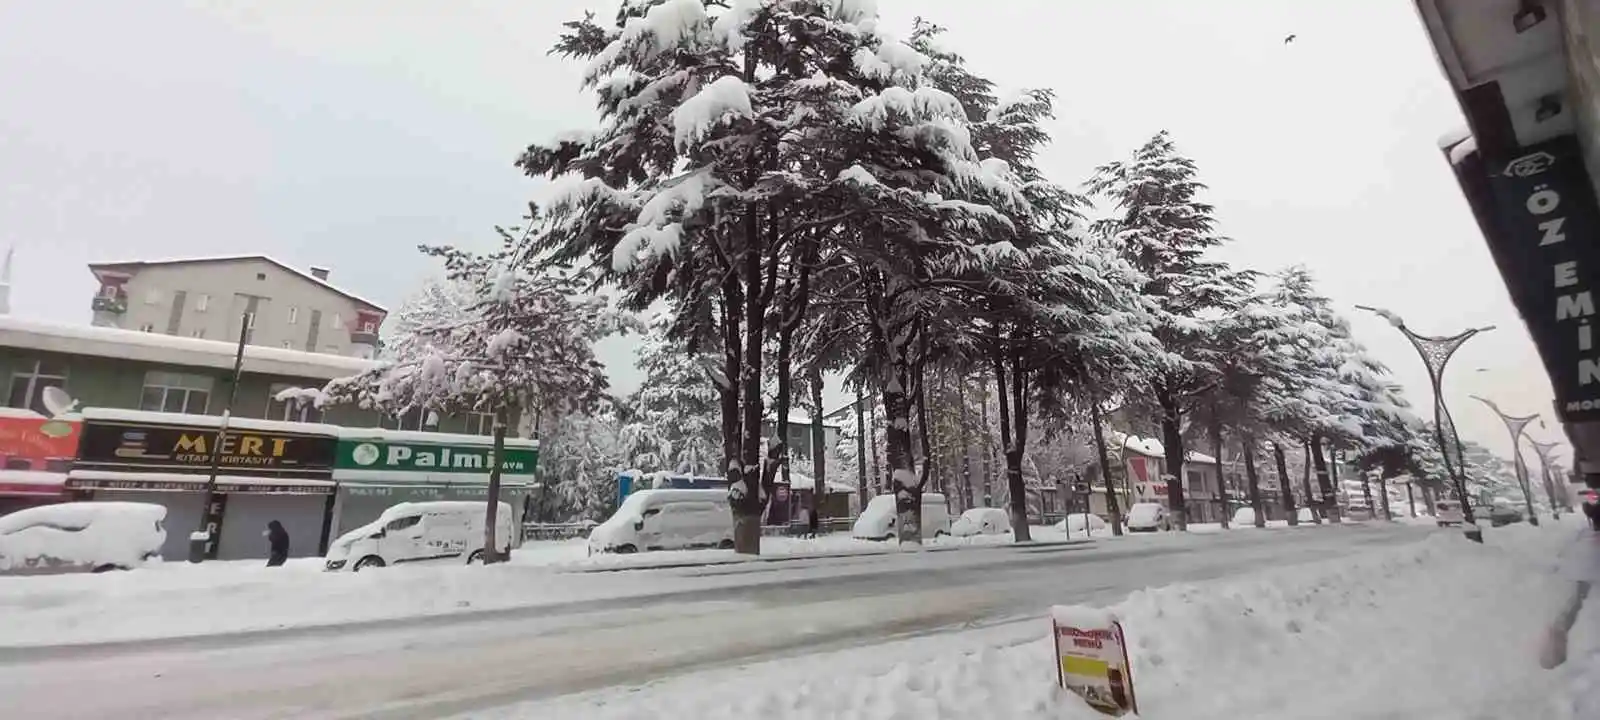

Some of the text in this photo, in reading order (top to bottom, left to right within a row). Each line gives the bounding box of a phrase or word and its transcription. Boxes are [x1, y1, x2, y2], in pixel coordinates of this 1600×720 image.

[1526, 183, 1566, 246] ÖZ
[173, 433, 292, 457] MERT
[386, 445, 495, 469] Palmi
[502, 462, 524, 470] AVM
